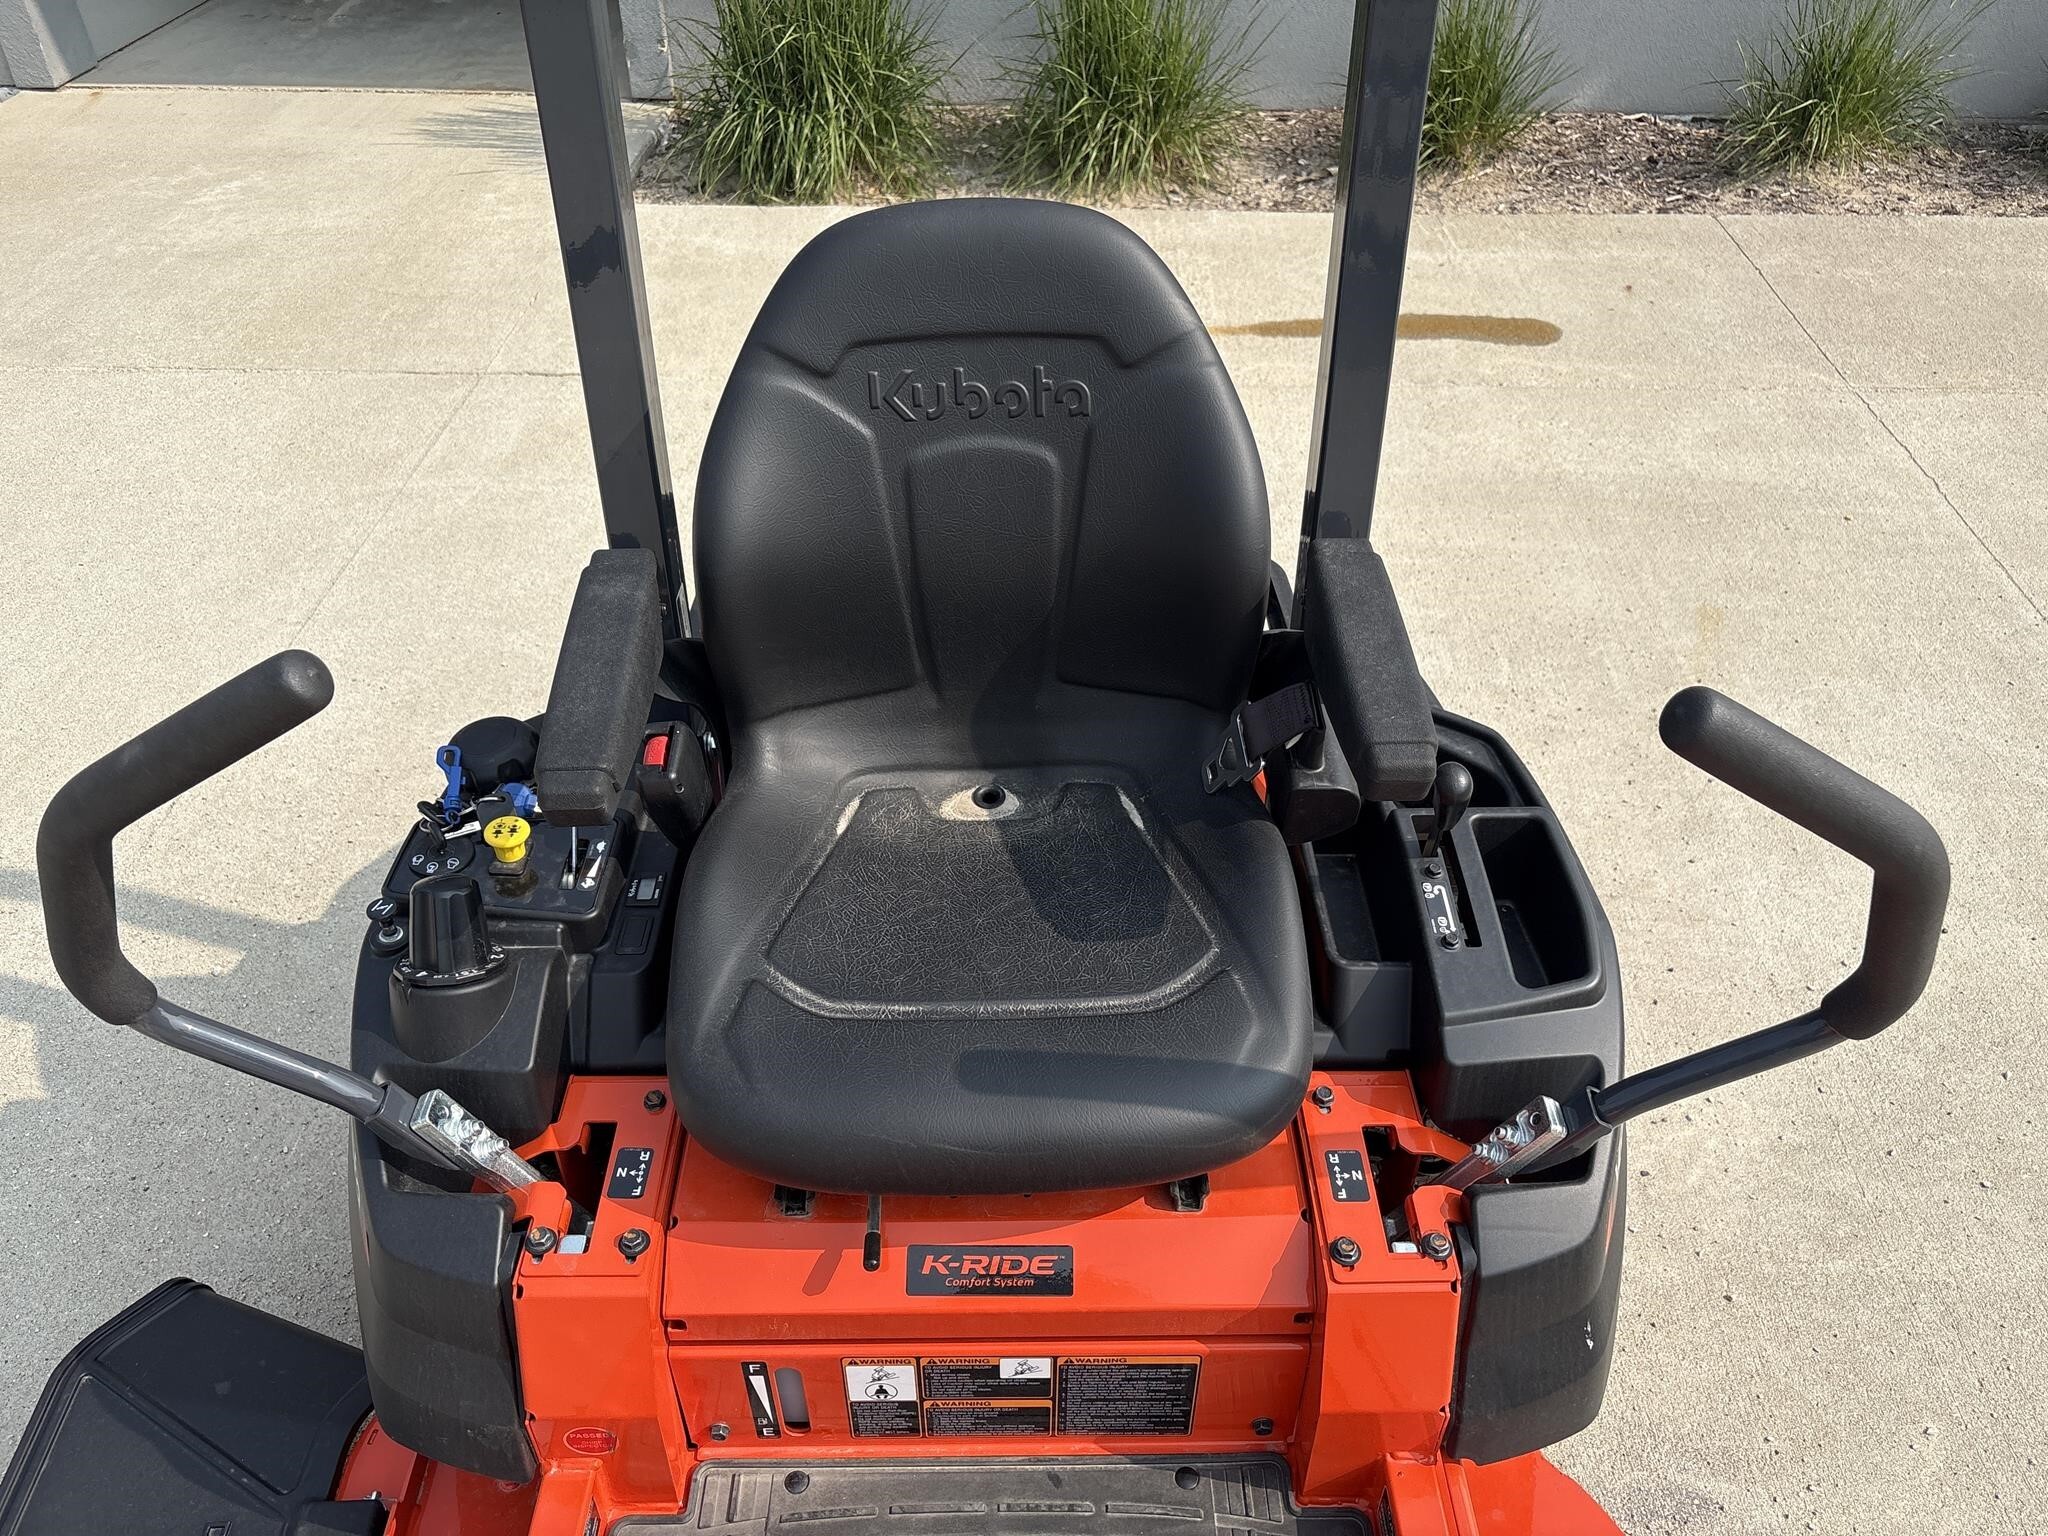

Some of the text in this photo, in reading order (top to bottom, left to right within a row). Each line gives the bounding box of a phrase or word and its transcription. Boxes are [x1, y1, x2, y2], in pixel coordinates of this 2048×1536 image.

[867, 365, 1092, 422] Kubota
[640, 1151, 650, 1161] R
[1328, 1153, 1340, 1164] R
[616, 1167, 628, 1177] N
[1351, 1170, 1363, 1180] N
[631, 1185, 642, 1196] F
[1337, 1188, 1347, 1199] F
[921, 1255, 1059, 1275] K-RIDE
[945, 1277, 1034, 1288] Comfort System
[748, 1364, 761, 1374] F
[762, 1427, 775, 1436] E
